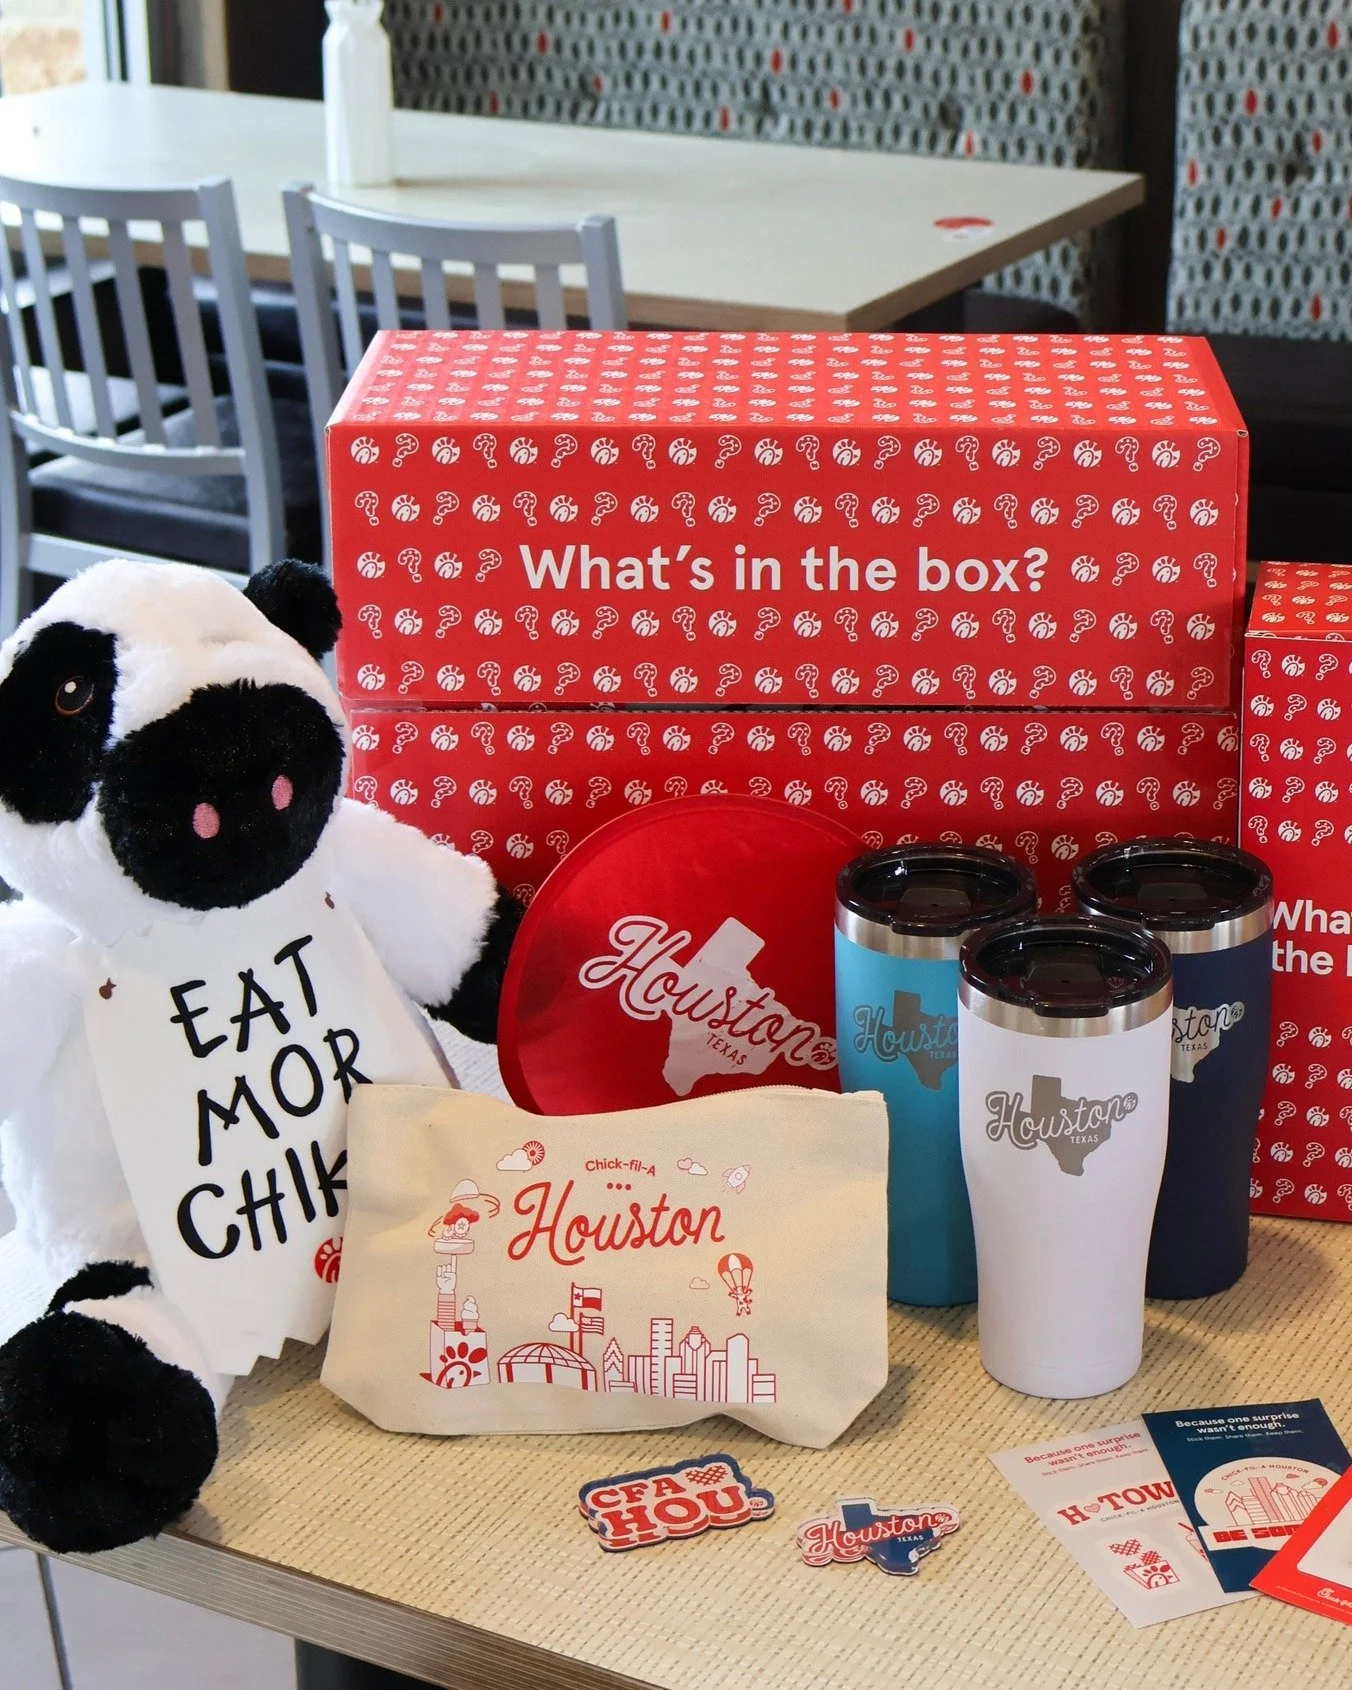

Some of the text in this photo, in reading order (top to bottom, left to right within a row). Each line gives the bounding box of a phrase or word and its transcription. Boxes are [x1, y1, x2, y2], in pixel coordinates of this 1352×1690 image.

[519, 544, 1049, 593] What's in the box?
[1273, 899, 1352, 935] Wha
[1272, 940, 1334, 976] the
[170, 934, 318, 1058] EAT
[583, 919, 812, 1062] Houston
[707, 1032, 747, 1066] TEXAS
[854, 1007, 958, 1060] Housto
[1181, 1042, 1208, 1052] TEXAS
[197, 1028, 374, 1167] MOR
[986, 1093, 1124, 1148] Houston
[1069, 1134, 1099, 1144] TEXAS
[585, 1158, 656, 1177] Chick-fil-A
[507, 1179, 725, 1266] Houston
[1175, 1412, 1300, 1428] Because one surprise
[1197, 1421, 1286, 1434] wasn't enough.
[1024, 1431, 1141, 1464] Because one surprise
[1048, 1443, 1132, 1467] wasn't enough.
[1221, 1464, 1309, 1481] CHICK-FIL-A HOUSTON
[591, 1476, 687, 1509] CFA
[601, 1485, 746, 1537] HOU
[1100, 1499, 1180, 1523] CHICK-FIL-A HOUSTON
[806, 1513, 938, 1554] Houston
[897, 1534, 924, 1543] TEXAS
[1212, 1528, 1248, 1543] BE
